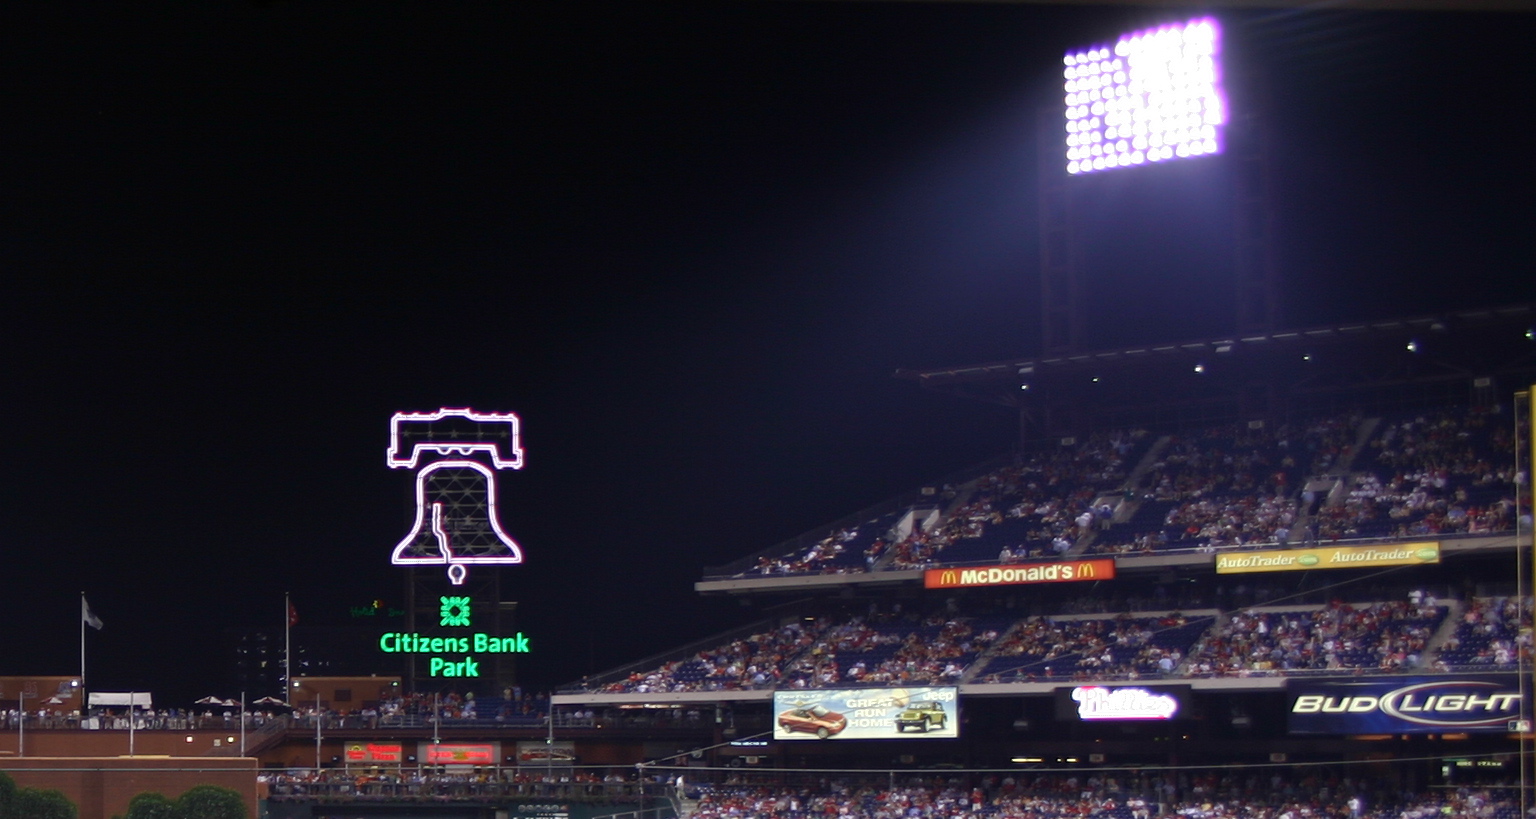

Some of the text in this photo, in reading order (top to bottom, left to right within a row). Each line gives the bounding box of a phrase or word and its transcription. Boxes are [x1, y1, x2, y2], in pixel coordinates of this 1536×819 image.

[1217, 554, 1295, 569] AutoTrader
[1330, 549, 1414, 563] AutoTrader
[960, 564, 1073, 584] McDonald's
[380, 632, 529, 653] Citizens Bank
[430, 657, 479, 677] Park
[846, 699, 893, 708] GREAT
[1074, 687, 1175, 714] Phillies
[1292, 694, 1524, 713] BUD LIGHT
[855, 709, 886, 717] RUN
[849, 718, 893, 728] HOME
